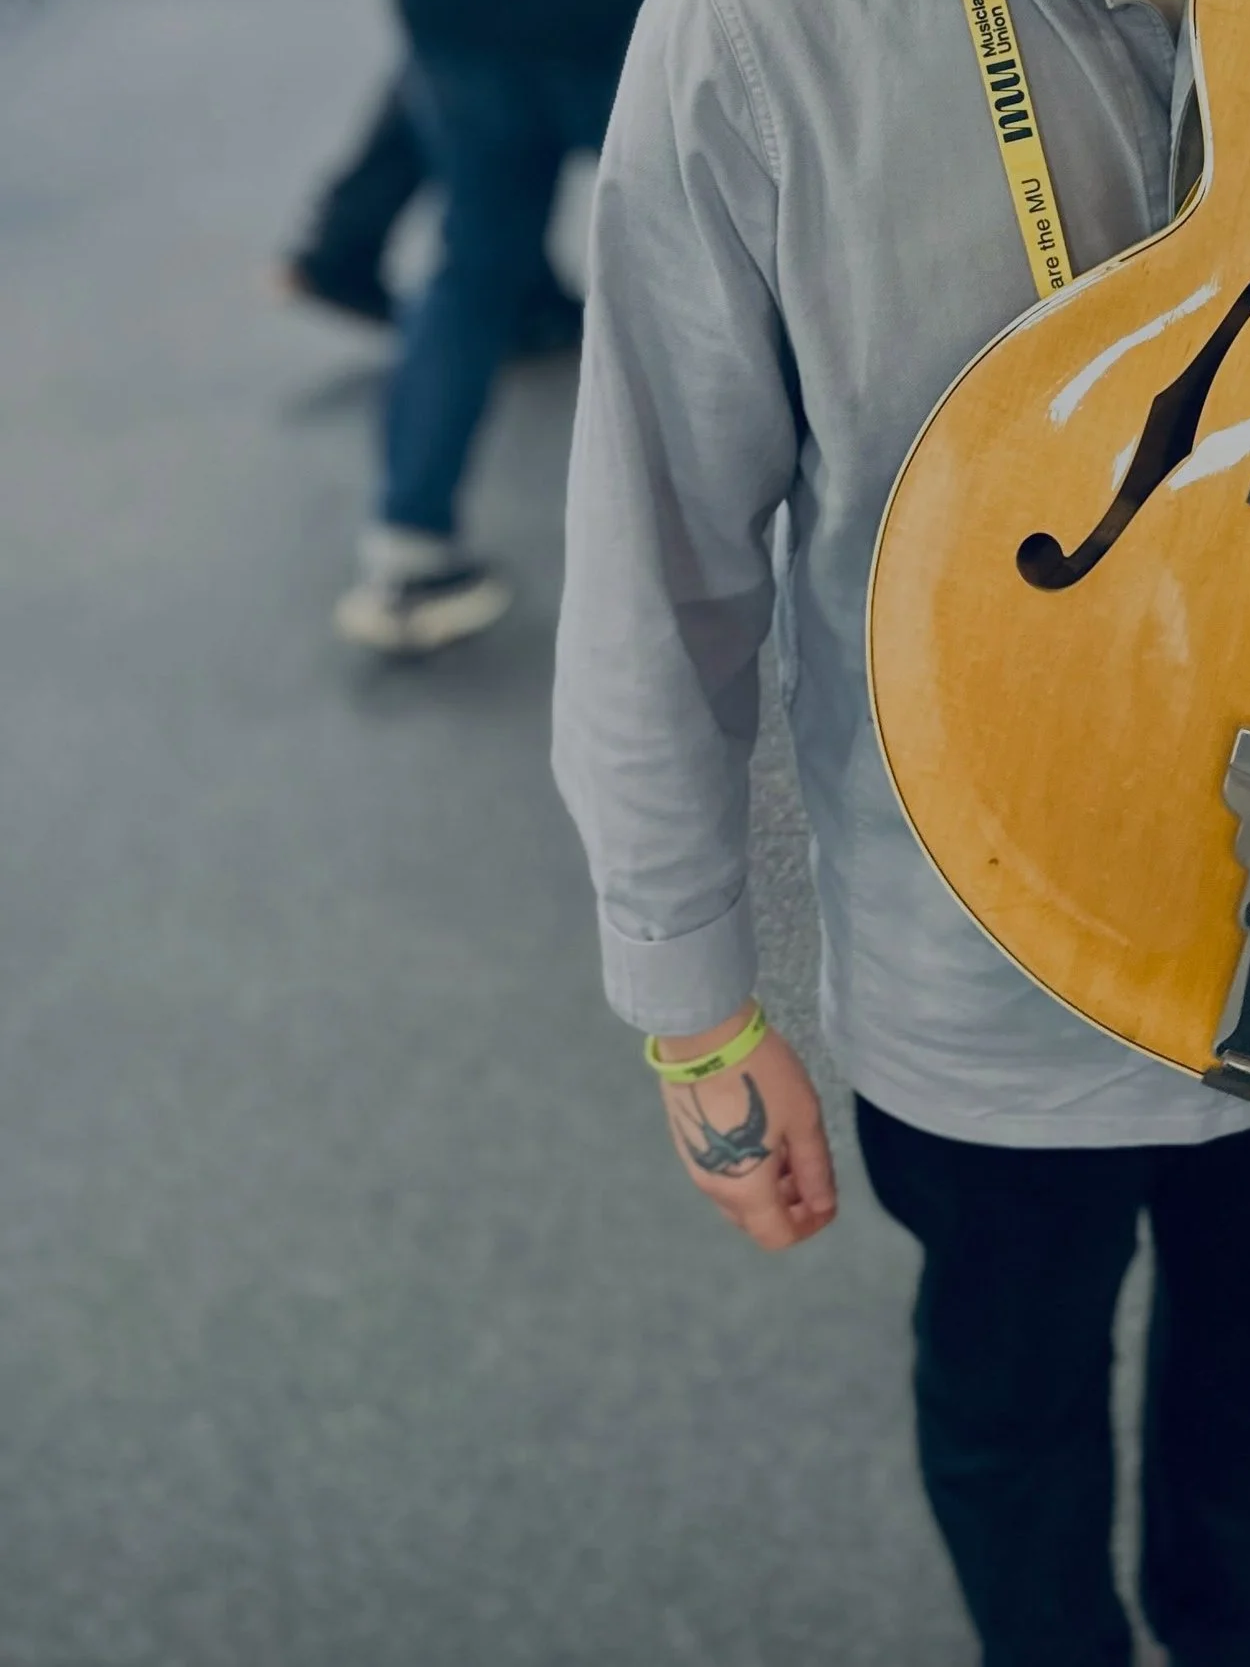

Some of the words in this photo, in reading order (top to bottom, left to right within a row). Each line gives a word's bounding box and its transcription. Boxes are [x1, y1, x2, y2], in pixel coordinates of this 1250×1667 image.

[991, 5, 1012, 55] Union
[1021, 177, 1047, 214] MU
[1036, 218, 1056, 251] the
[1046, 256, 1065, 290] are
